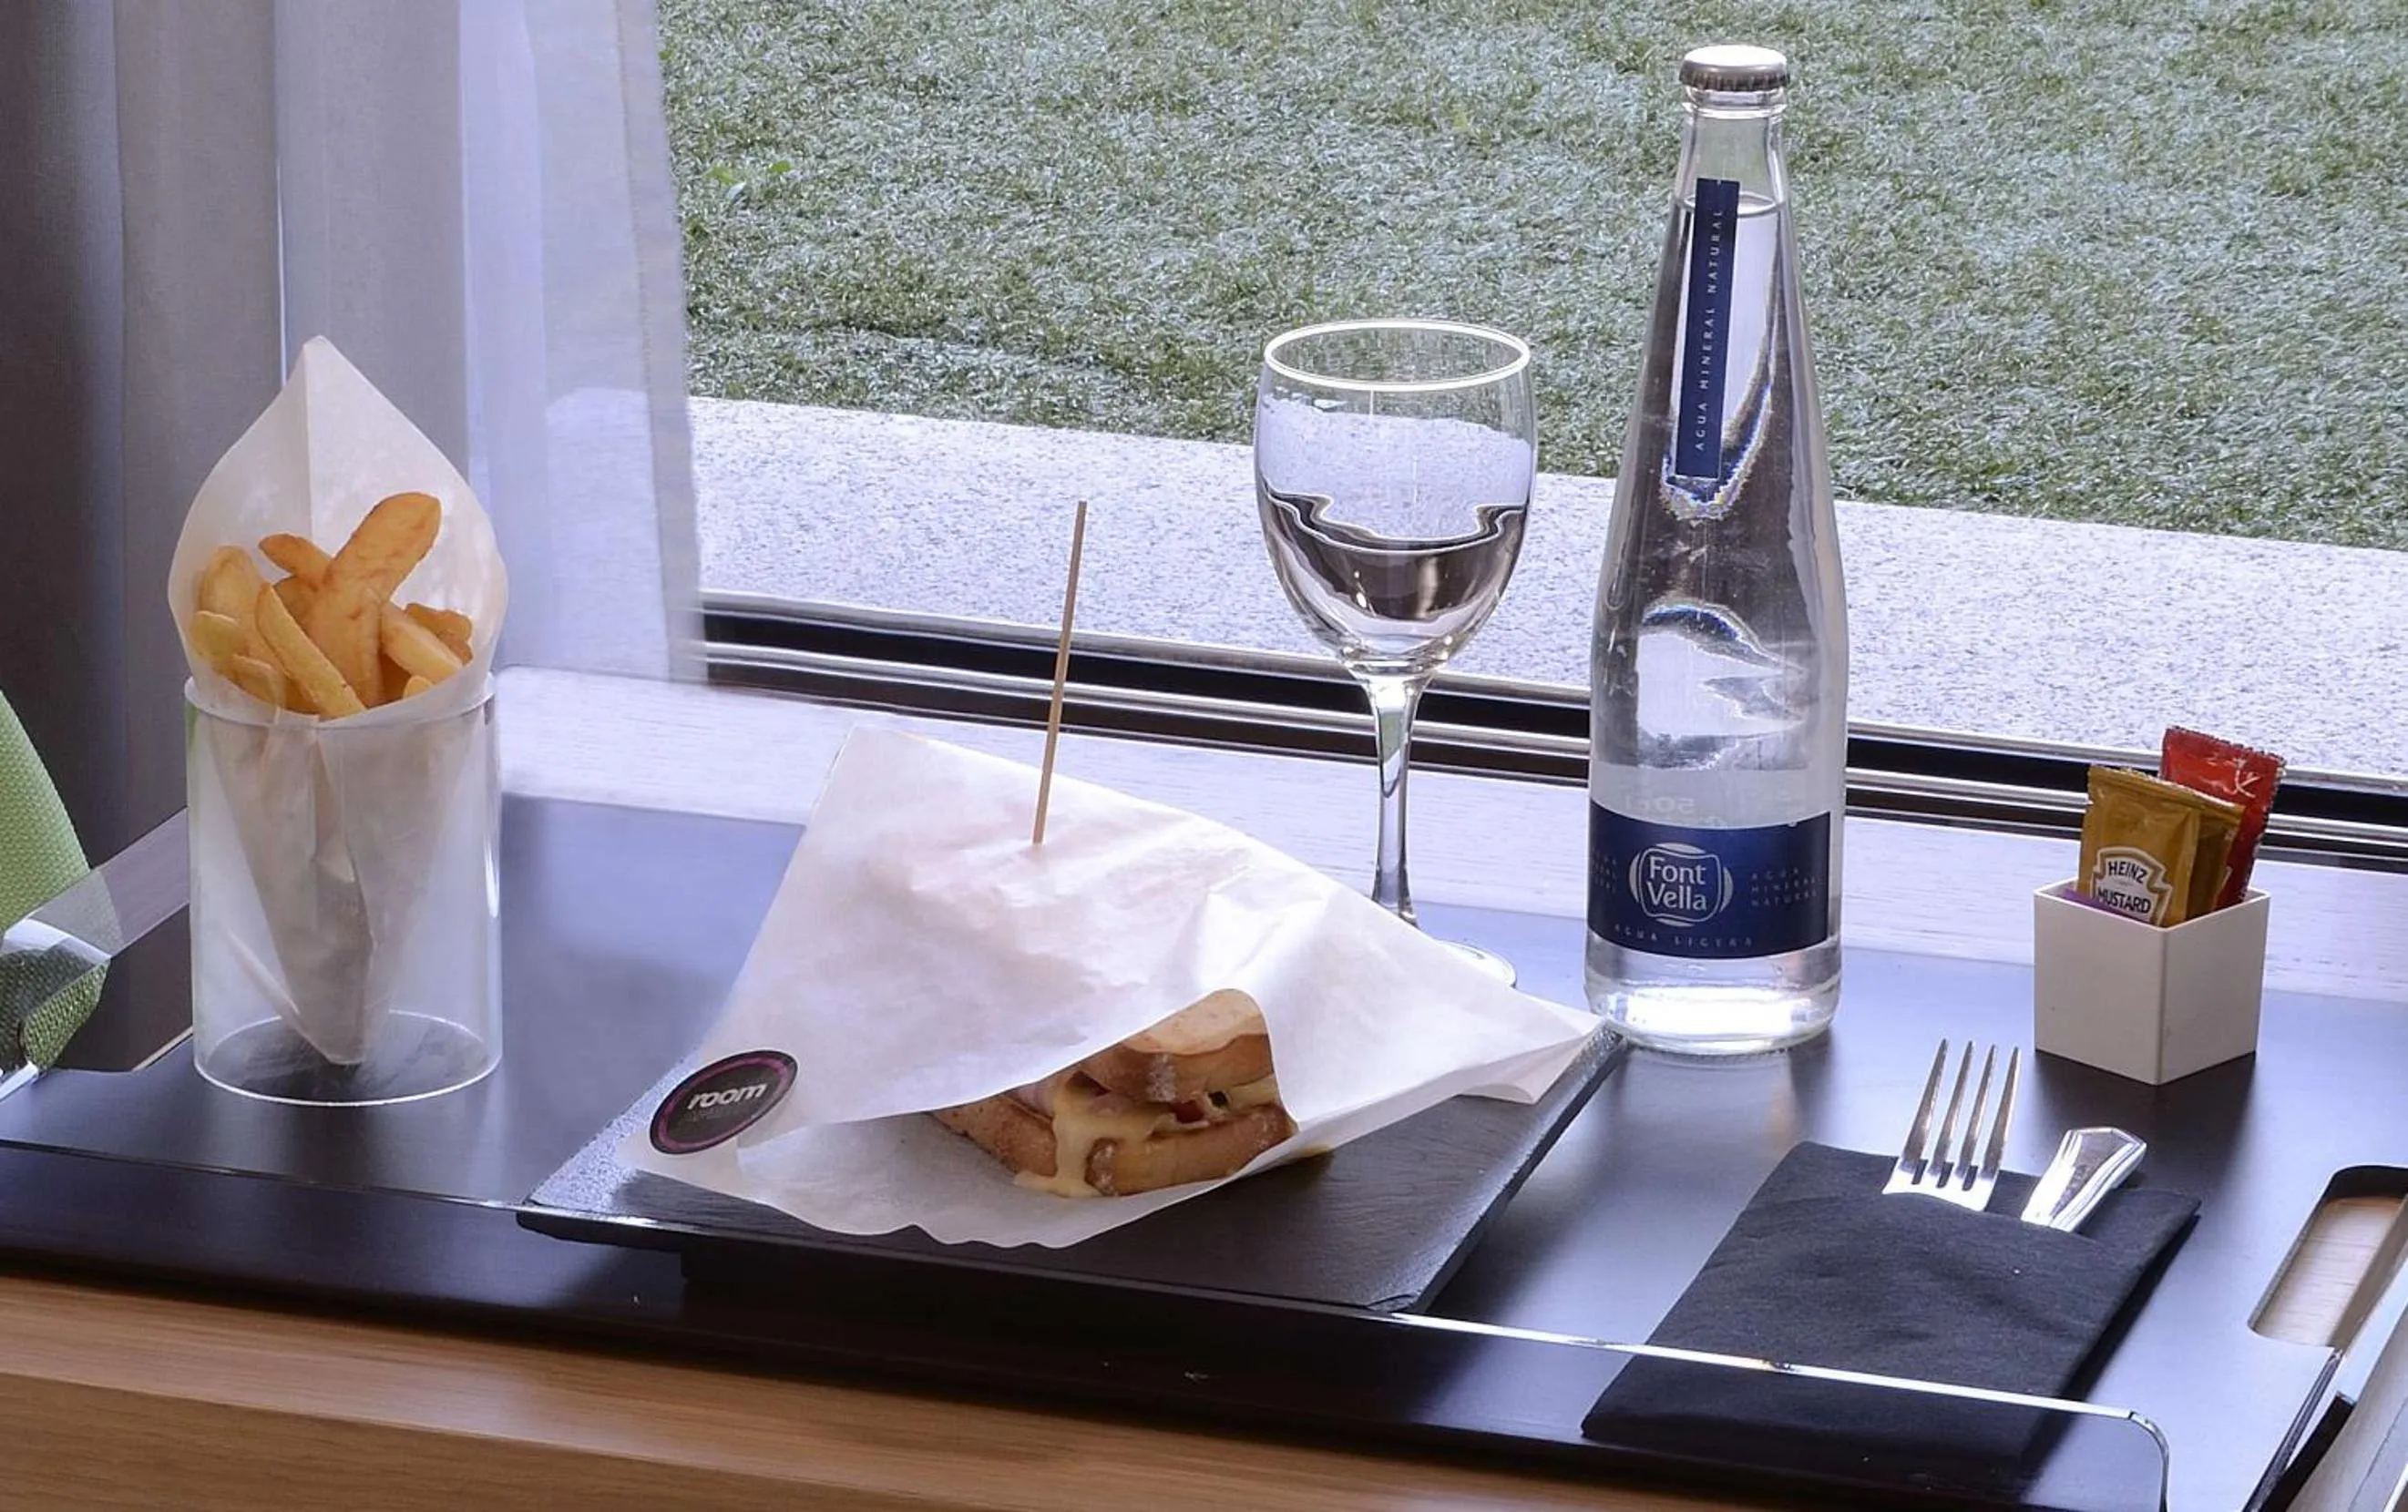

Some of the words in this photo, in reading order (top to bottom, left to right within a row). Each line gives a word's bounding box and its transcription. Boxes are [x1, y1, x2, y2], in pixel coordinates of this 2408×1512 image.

[1706, 210, 1723, 293] NATURAL
[1700, 309, 1715, 390] MINERAL
[1695, 402, 1708, 451] AGUA
[1649, 856, 1706, 885] Font
[2107, 861, 2147, 884] HEINZ
[1646, 882, 1706, 911] Vella
[2098, 887, 2151, 914] MUSTARD
[688, 1083, 768, 1109] room
